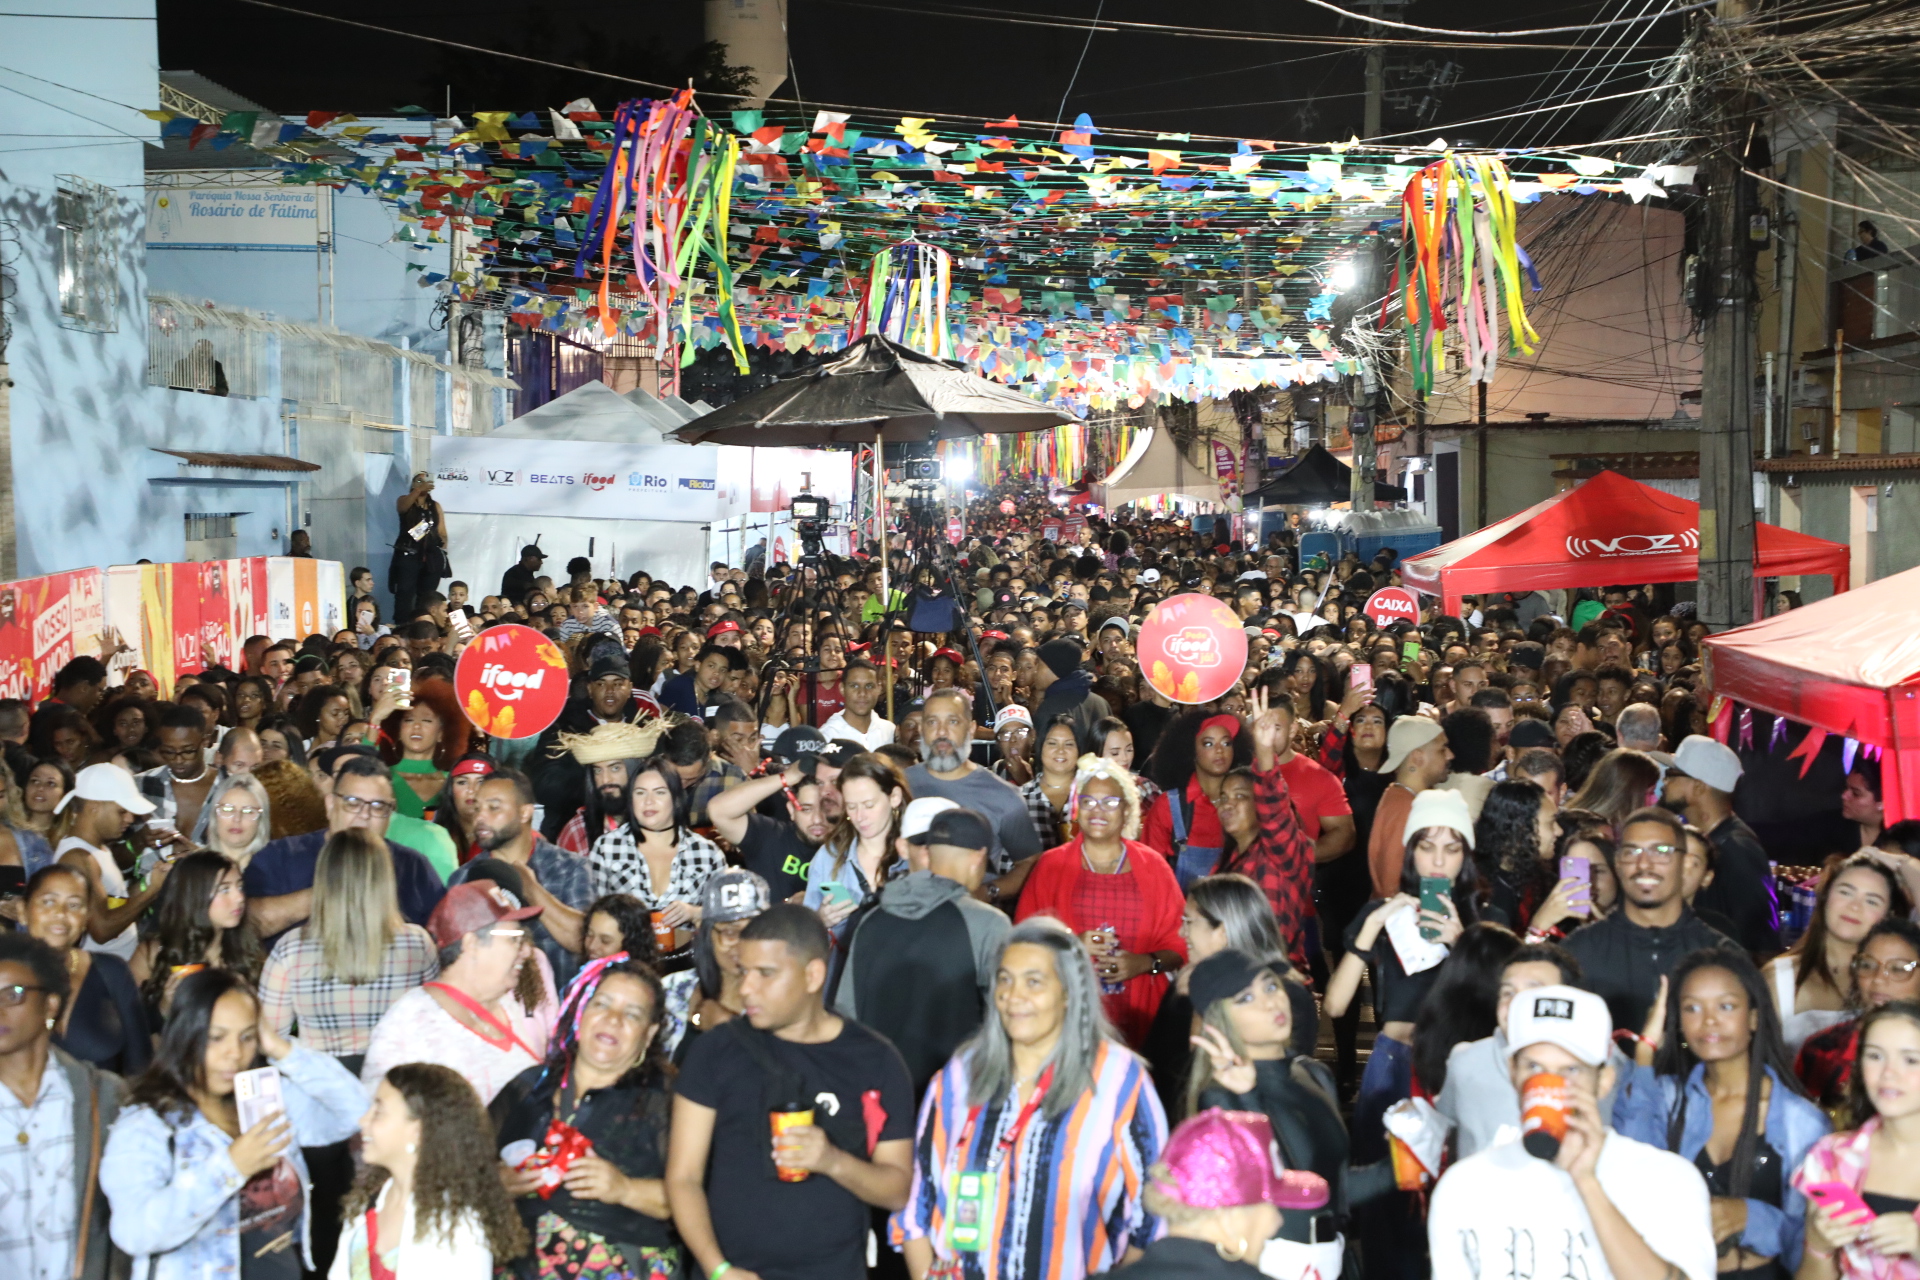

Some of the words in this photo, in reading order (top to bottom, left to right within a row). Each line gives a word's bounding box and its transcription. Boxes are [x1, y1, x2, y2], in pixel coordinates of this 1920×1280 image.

[189, 190, 232, 203] Paróquia
[234, 191, 261, 201] Nossa
[263, 191, 301, 203] Senhora
[189, 201, 244, 217] Rosário
[248, 203, 266, 218] de
[269, 203, 318, 219] Fátima
[437, 473, 469, 481] ALEMÃO
[487, 469, 514, 483] VOZ
[530, 474, 575, 485] BEATS
[644, 474, 668, 488] Rio
[689, 479, 716, 490] Riotur
[1588, 534, 1680, 552] VOZ
[1374, 597, 1414, 613] CAIXA
[1377, 614, 1400, 627] BA
[36, 604, 68, 653] NOSSO
[1170, 638, 1212, 654] ifood
[480, 663, 546, 690] ifood
